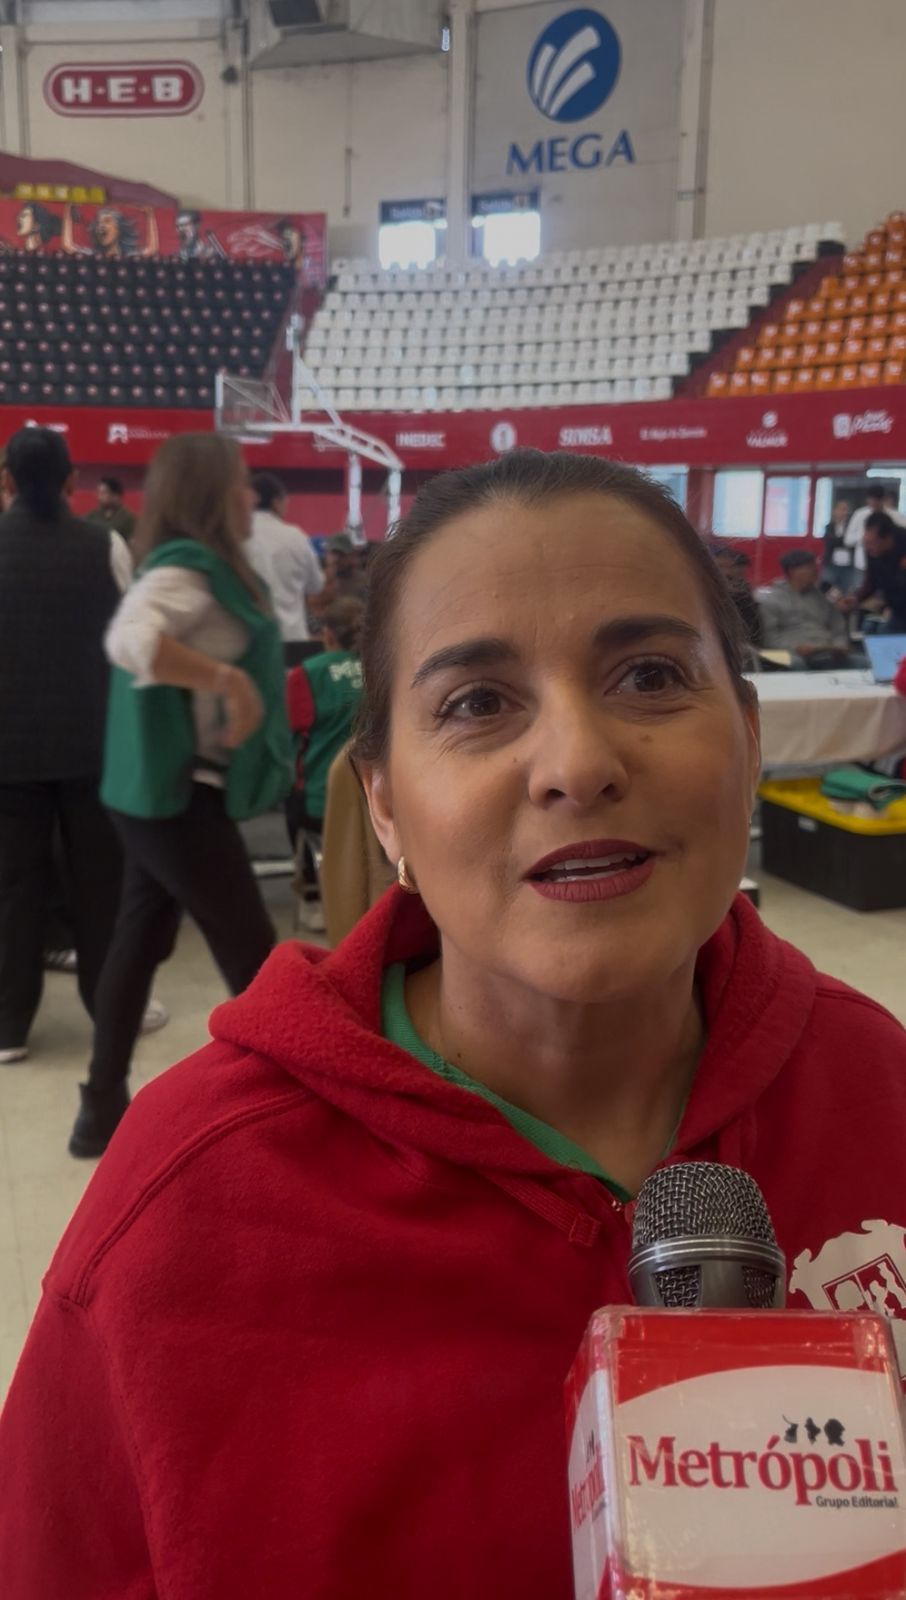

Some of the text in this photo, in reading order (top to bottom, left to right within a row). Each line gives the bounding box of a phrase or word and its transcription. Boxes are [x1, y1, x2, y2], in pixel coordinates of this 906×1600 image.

[506, 129, 636, 175] MEGA
[626, 1434, 899, 1506] Metrópoli
[815, 1495, 897, 1509] Grupo Editorial
